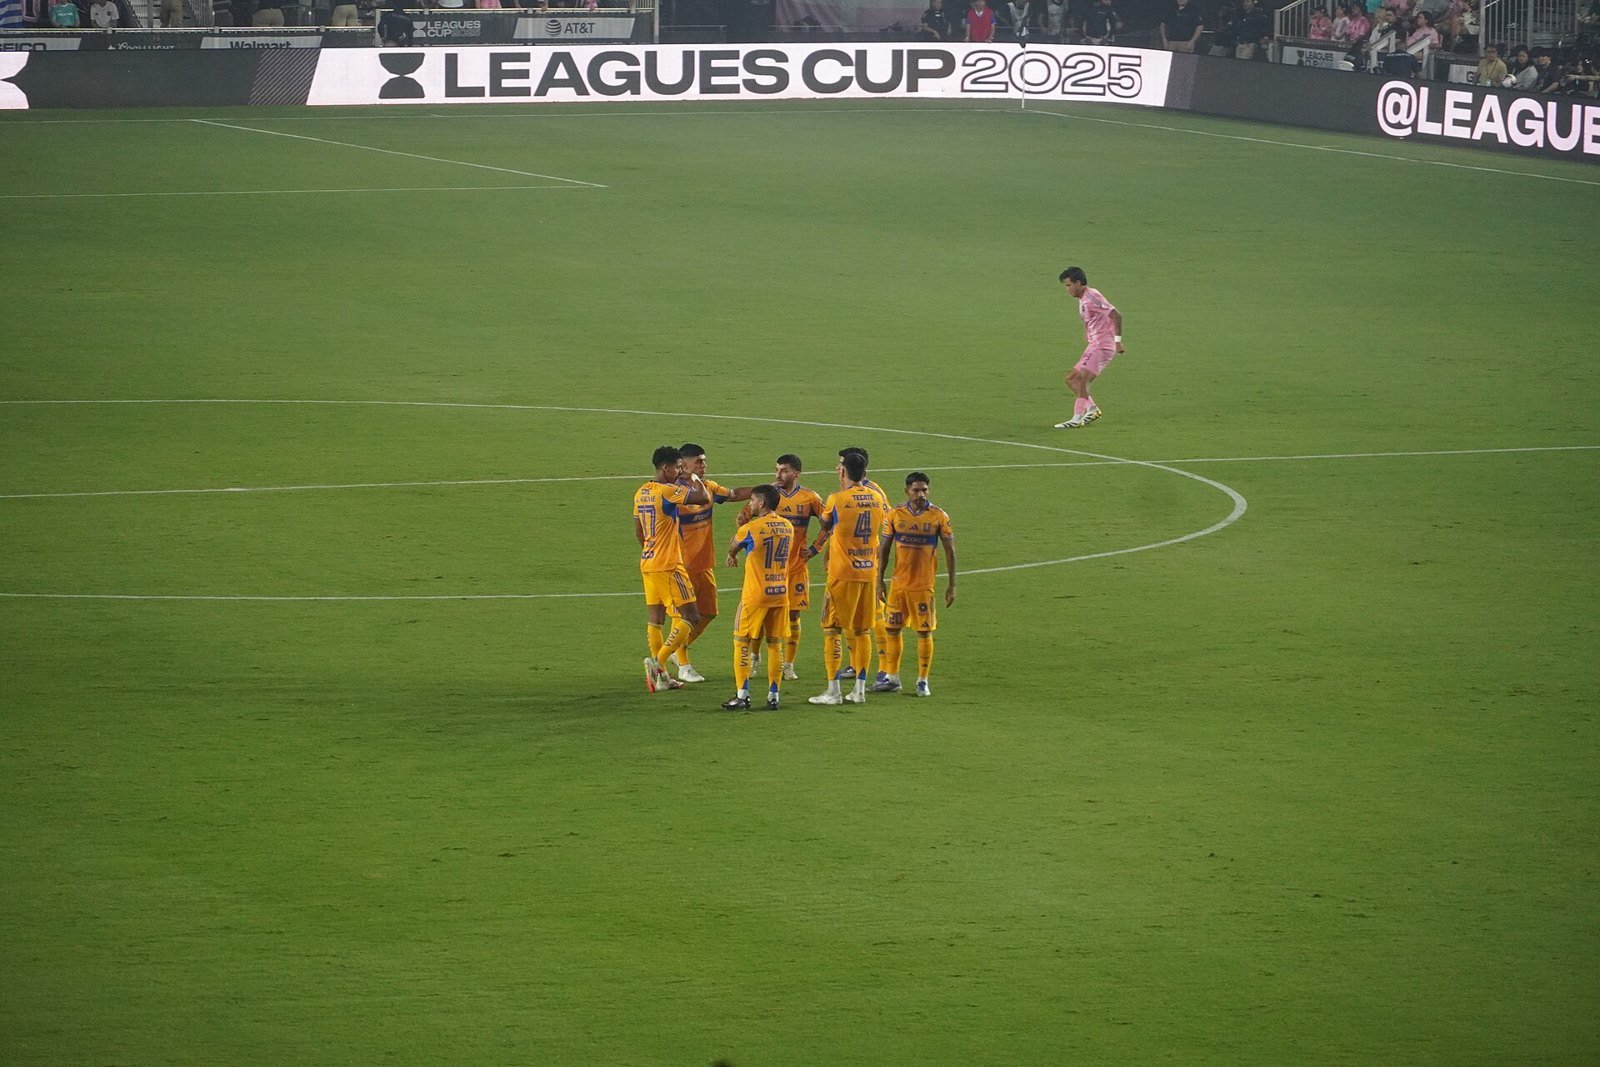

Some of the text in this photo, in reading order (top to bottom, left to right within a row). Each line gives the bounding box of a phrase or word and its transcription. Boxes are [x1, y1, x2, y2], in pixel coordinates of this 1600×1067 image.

[427, 20, 481, 29] LEAGUES
[564, 22, 596, 33] AT&T
[427, 29, 452, 38] CUP
[0, 42, 47, 50] EICO
[230, 41, 291, 49] Walmart
[1304, 50, 1334, 61] LEAGUES
[445, 49, 1143, 98] LEAGUES CUP 2025
[638, 504, 656, 537] 17
[853, 510, 872, 545] 4
[762, 535, 790, 569] 14
